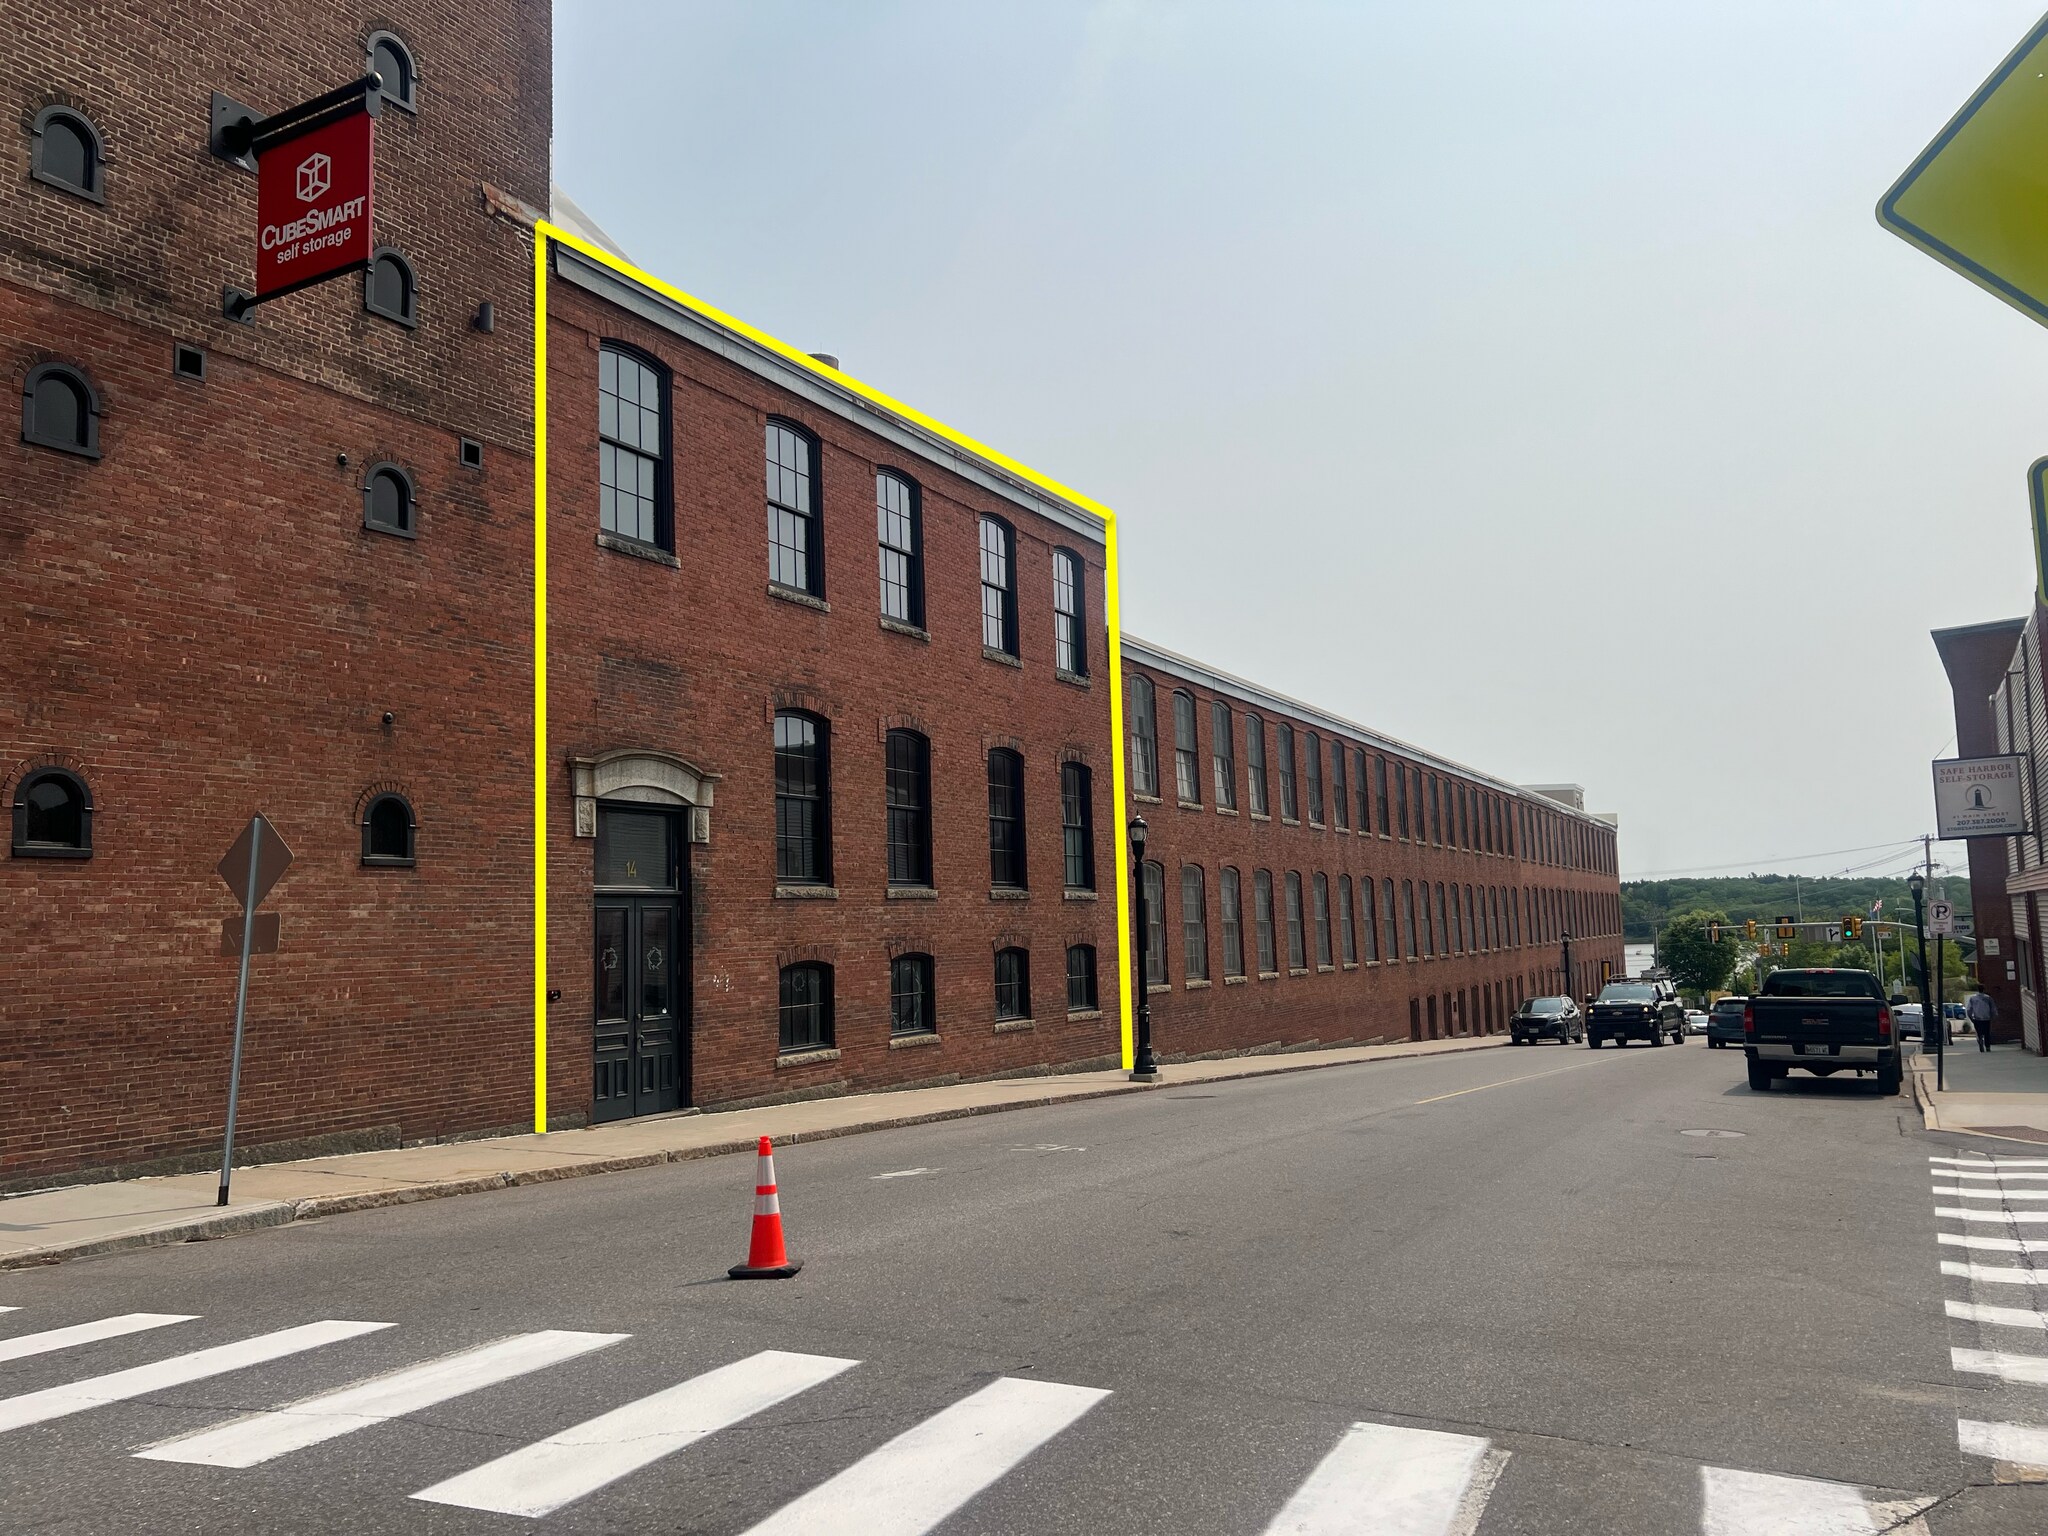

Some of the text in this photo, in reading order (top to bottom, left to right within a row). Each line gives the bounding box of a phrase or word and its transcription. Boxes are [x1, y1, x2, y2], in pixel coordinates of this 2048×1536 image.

[277, 227, 352, 264] self storage
[1940, 764, 2012, 776] SAFE HARBOR
[1940, 772, 2014, 783] SELF-STORAGE
[626, 856, 636, 877] 14
